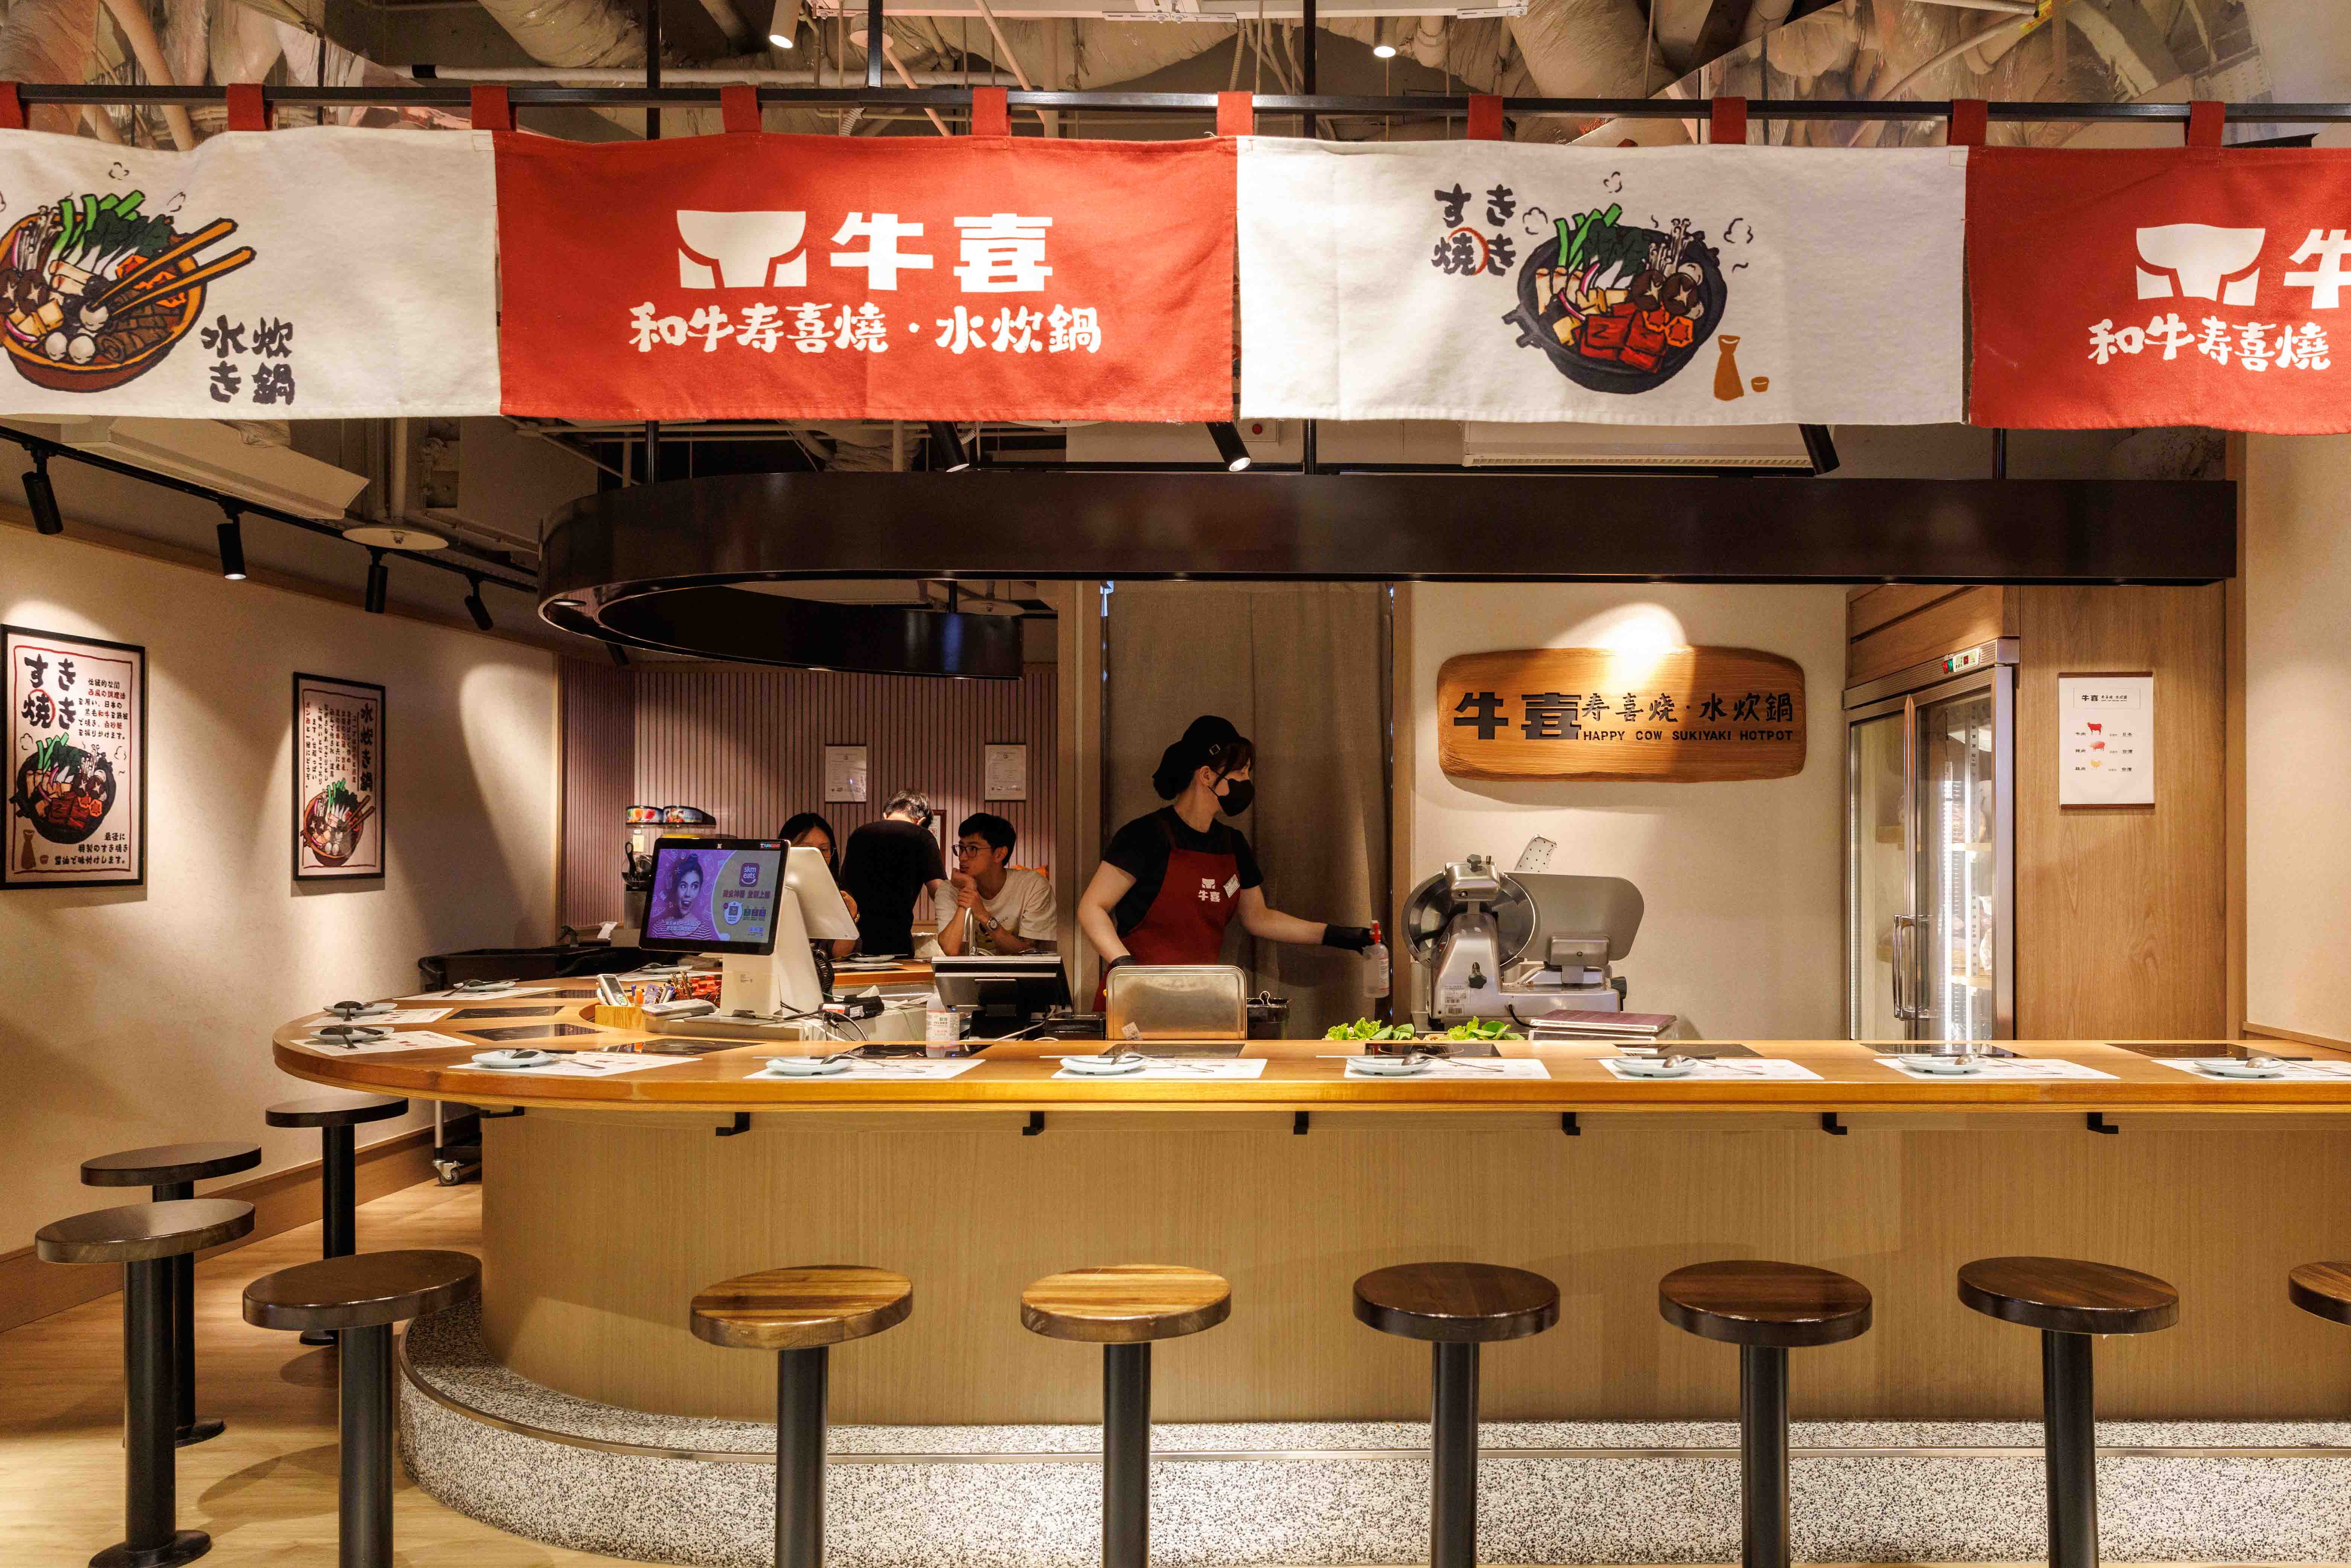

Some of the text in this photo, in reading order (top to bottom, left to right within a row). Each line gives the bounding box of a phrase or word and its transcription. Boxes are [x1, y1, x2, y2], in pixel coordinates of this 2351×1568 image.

[1434, 183, 1516, 228] すき
[830, 212, 1053, 293] 牛喜
[1431, 232, 1516, 276] 焼き
[24, 654, 76, 691] すき
[21, 693, 76, 730] 焼き
[1454, 691, 1582, 740] 牛喜
[1583, 731, 1794, 741] HAPPY COW SUKIYAKI HOTPOT
[1198, 890, 1221, 902] 牛喜
